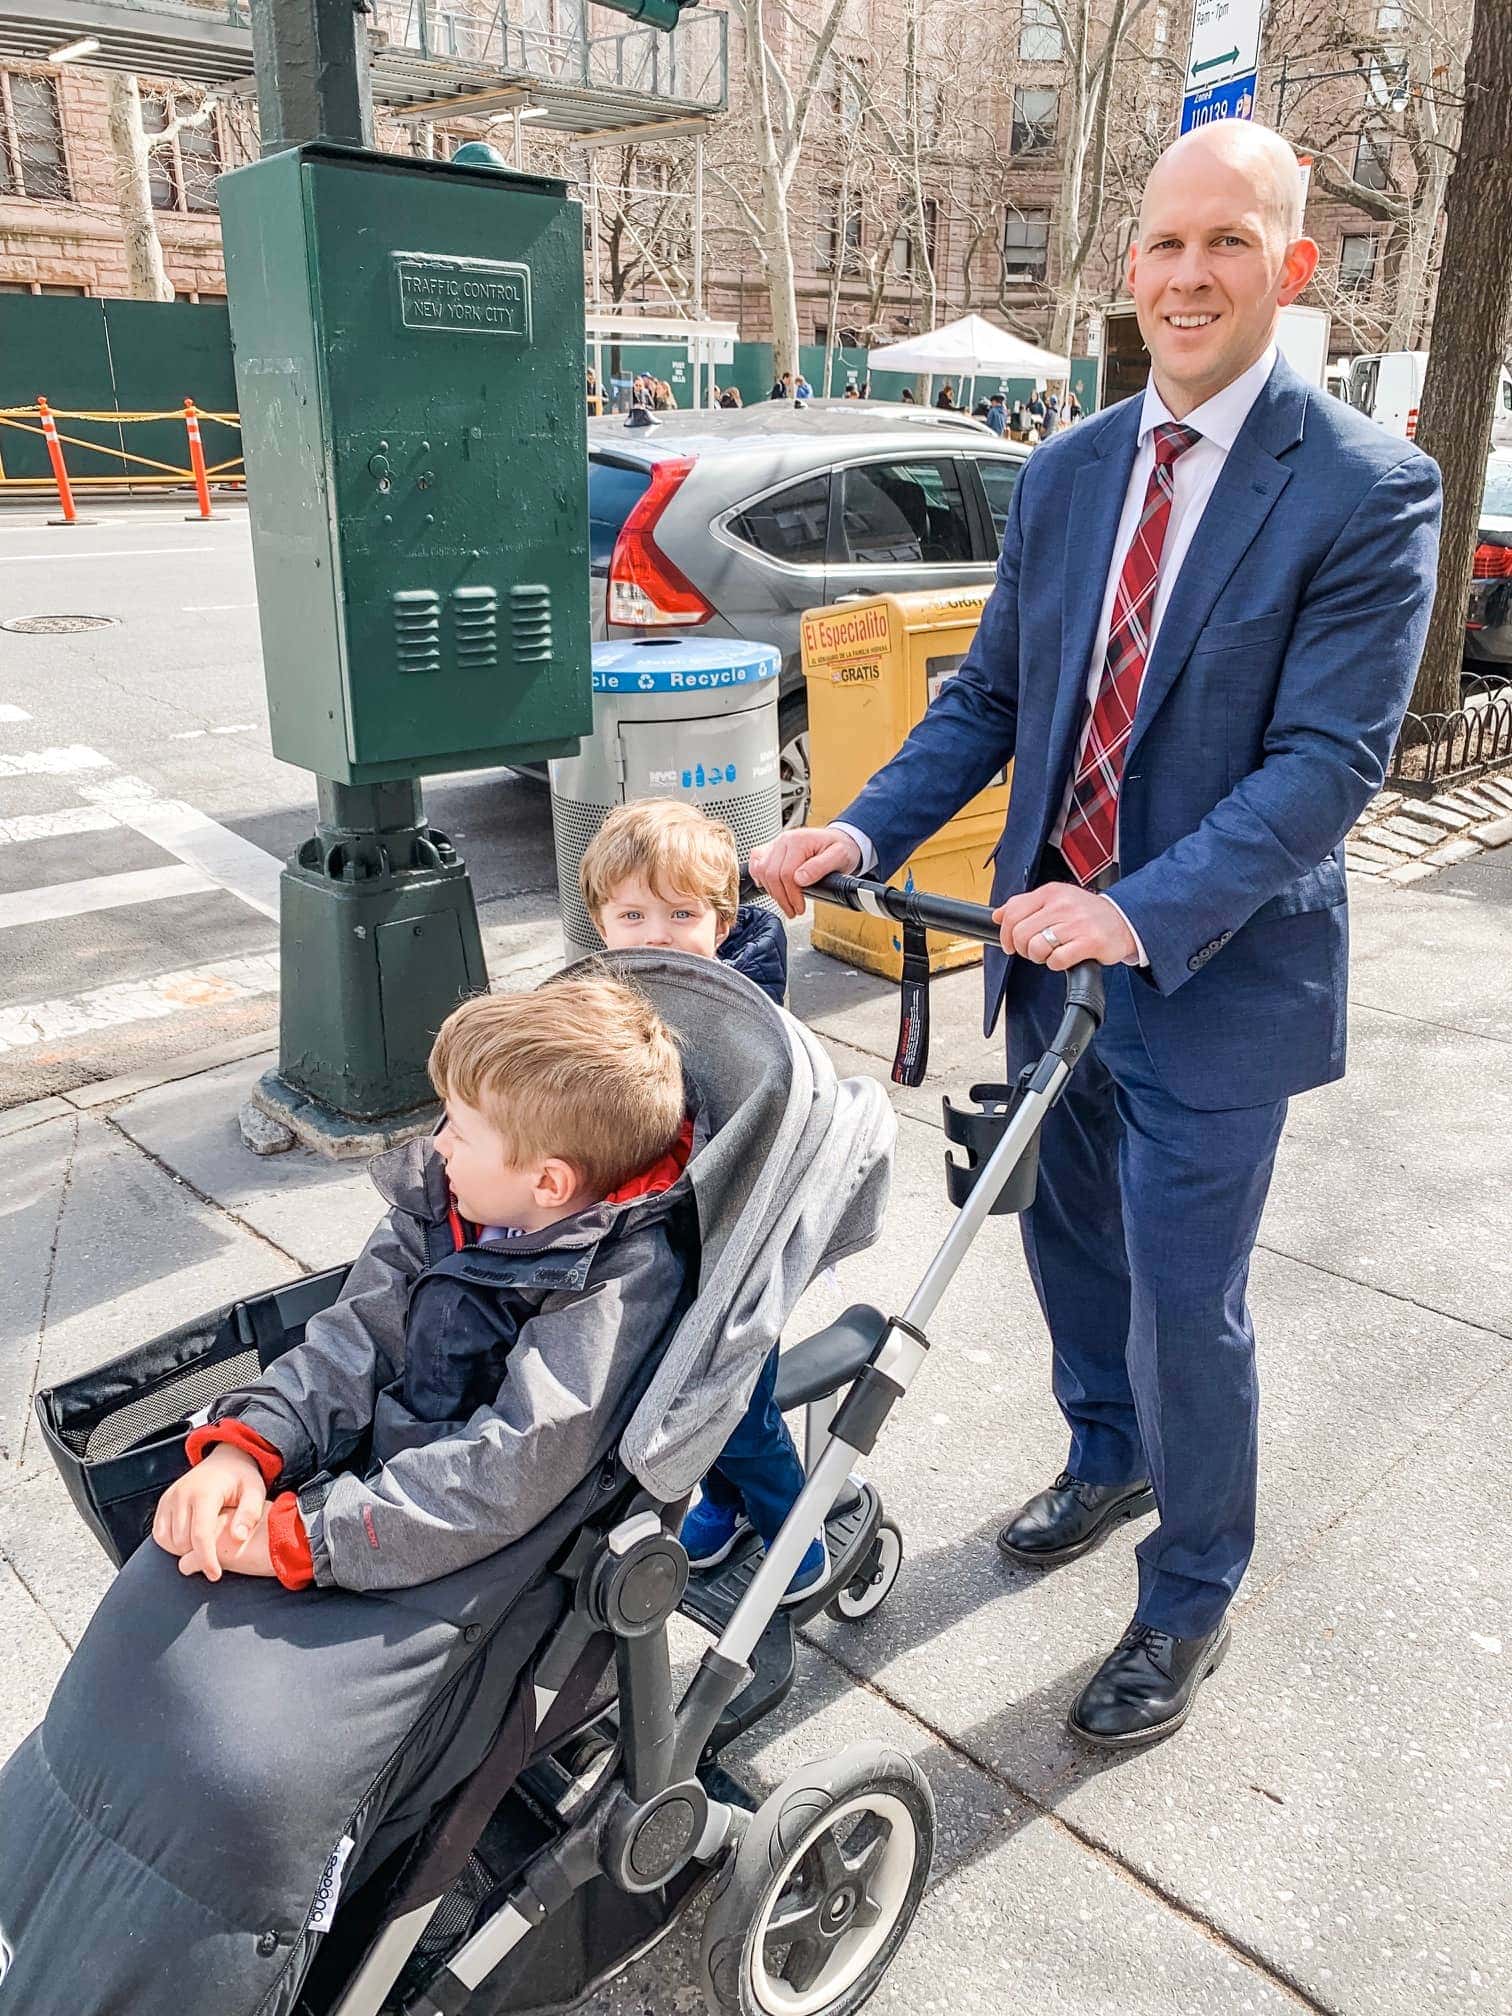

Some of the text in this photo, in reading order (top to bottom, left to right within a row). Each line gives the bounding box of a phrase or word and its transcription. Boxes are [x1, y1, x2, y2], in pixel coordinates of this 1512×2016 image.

[404, 276, 521, 301] TRAFFIC CONTROL
[414, 301, 514, 326] NEW YORK CITY
[805, 610, 888, 652] El Especialito
[670, 667, 746, 687] Recycle
[841, 664, 880, 682] GRATIS
